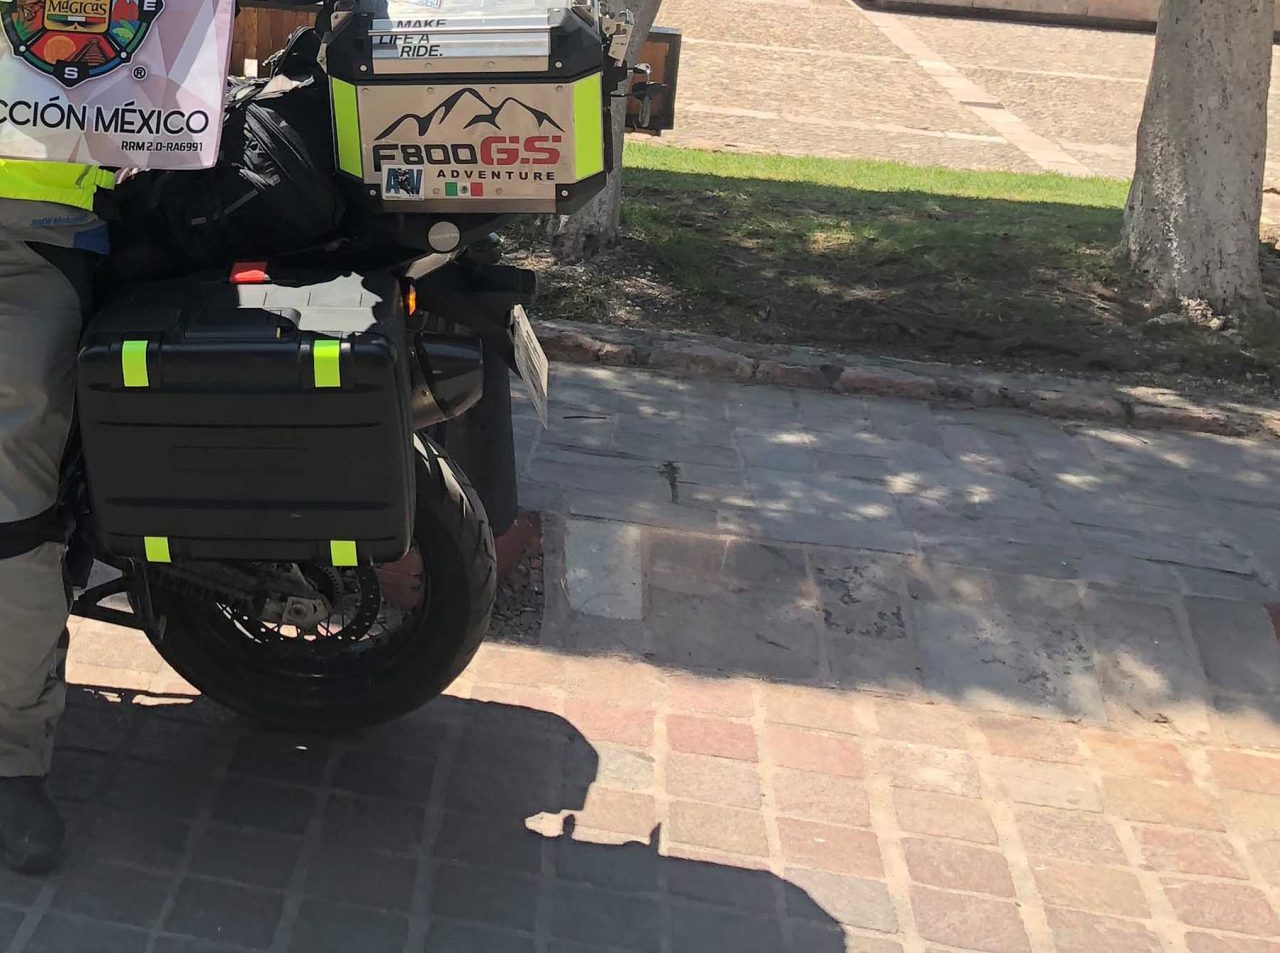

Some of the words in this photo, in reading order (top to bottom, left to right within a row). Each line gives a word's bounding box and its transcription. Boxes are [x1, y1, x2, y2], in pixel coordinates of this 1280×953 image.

[144, 0, 157, 11] E
[378, 33, 414, 45] LIFE
[418, 33, 431, 44] A
[400, 45, 444, 58] RIDE.
[64, 67, 79, 79] S
[95, 101, 209, 135] MÉXICO
[121, 141, 145, 152] RRM
[146, 141, 204, 152] 2.0-RA6991
[437, 169, 555, 181] ADVENTURE
